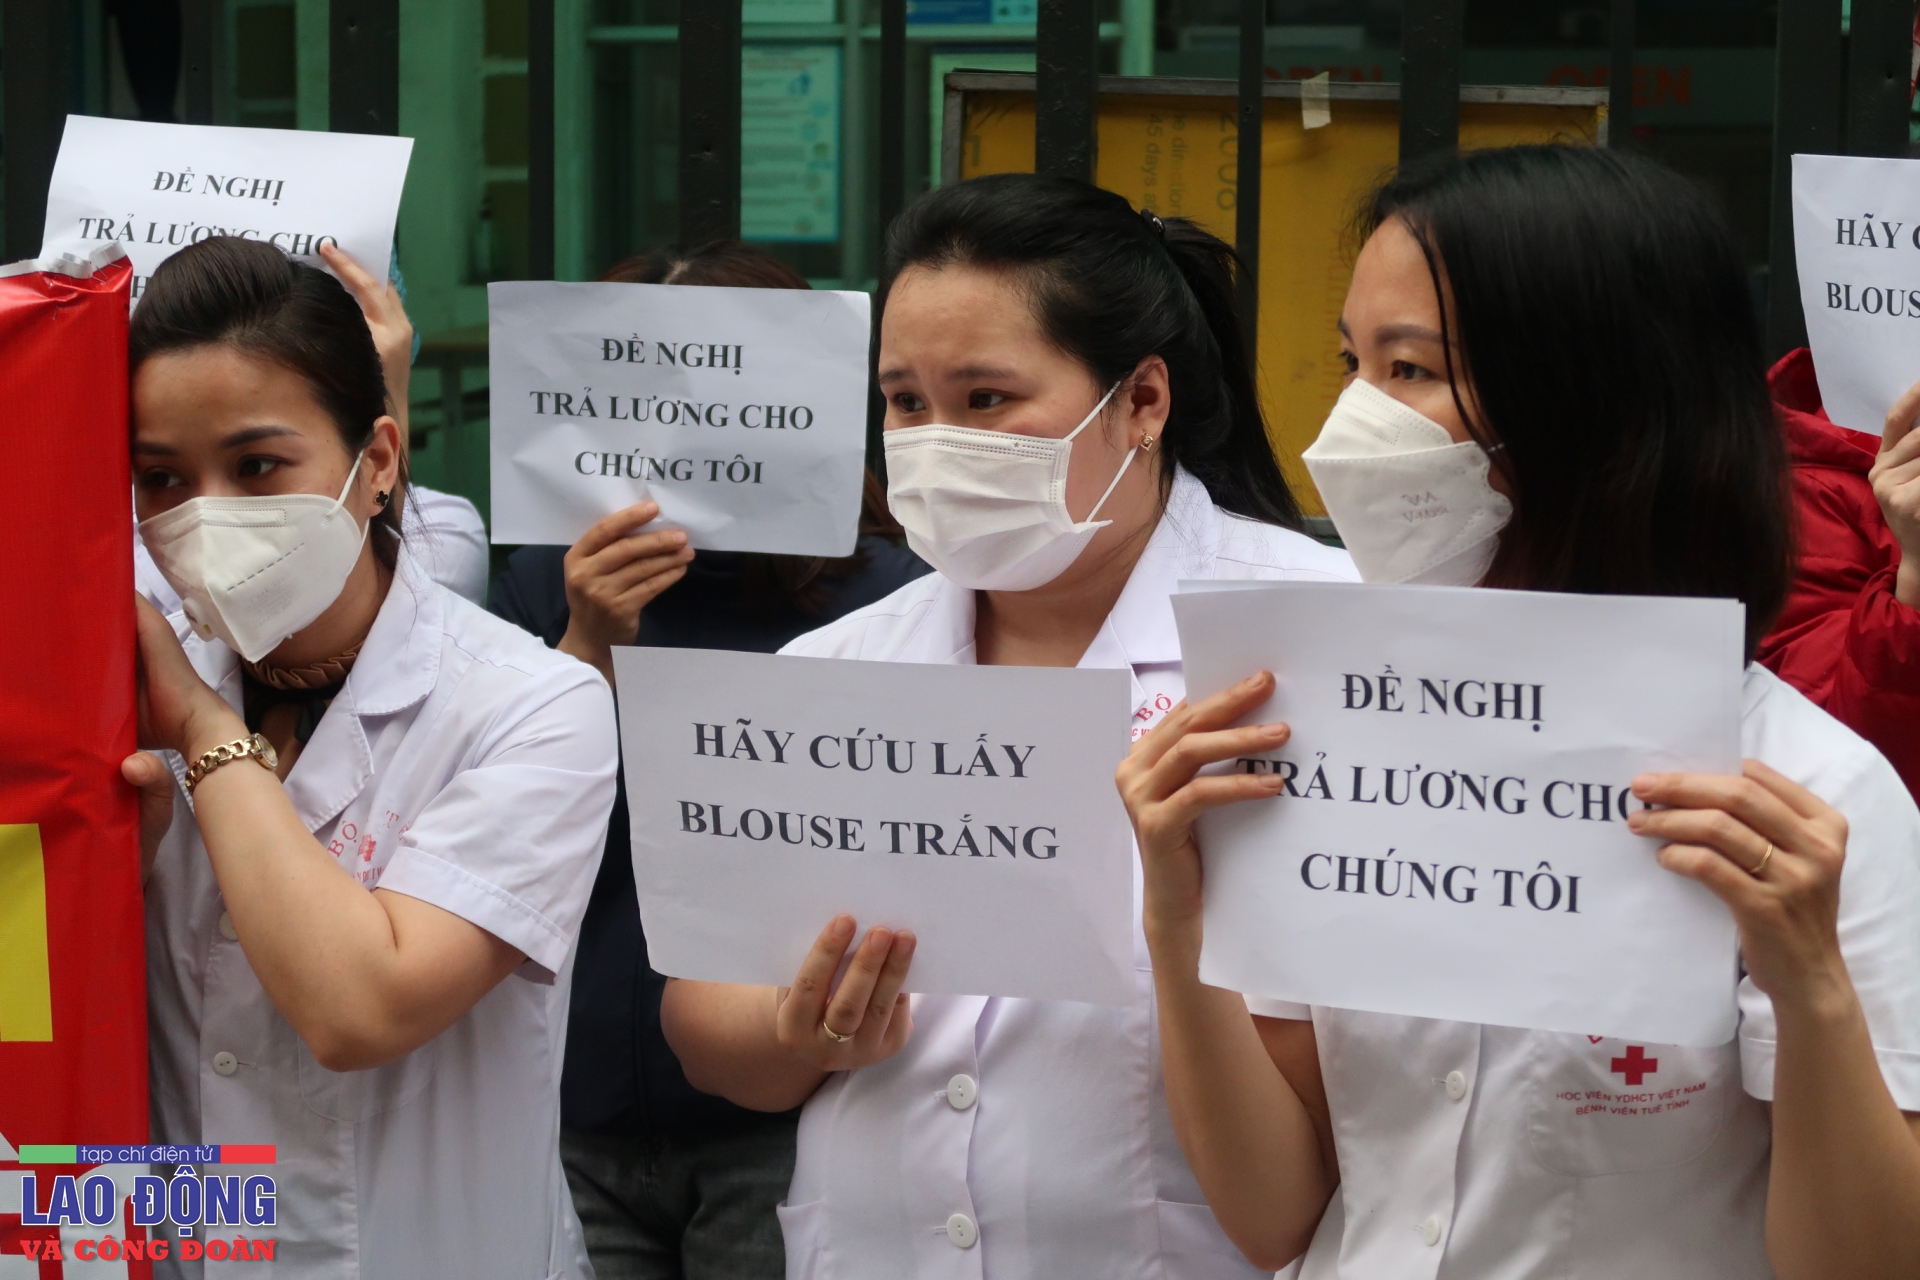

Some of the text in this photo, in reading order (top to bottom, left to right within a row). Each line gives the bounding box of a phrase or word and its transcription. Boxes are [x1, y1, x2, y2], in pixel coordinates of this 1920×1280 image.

[200, 174, 286, 206] NGHỊ
[79, 213, 135, 242] TRẢ
[1835, 213, 1903, 249] HÃY
[601, 333, 744, 375] ĐỀ NGHỊ
[530, 386, 814, 430] TRẢ LƯƠNG CHO
[574, 448, 764, 485] CHÚNG TÔI
[1341, 664, 1546, 733] ĐỀ NGHỊ
[692, 717, 1037, 778] HÃY CỨU LẤY
[1349, 763, 1527, 815] LƯƠNG
[677, 800, 1060, 860] BLOUSE TRẮNG
[1300, 848, 1582, 914] CHÚNG TÔI
[1684, 1082, 1706, 1095] NAM
